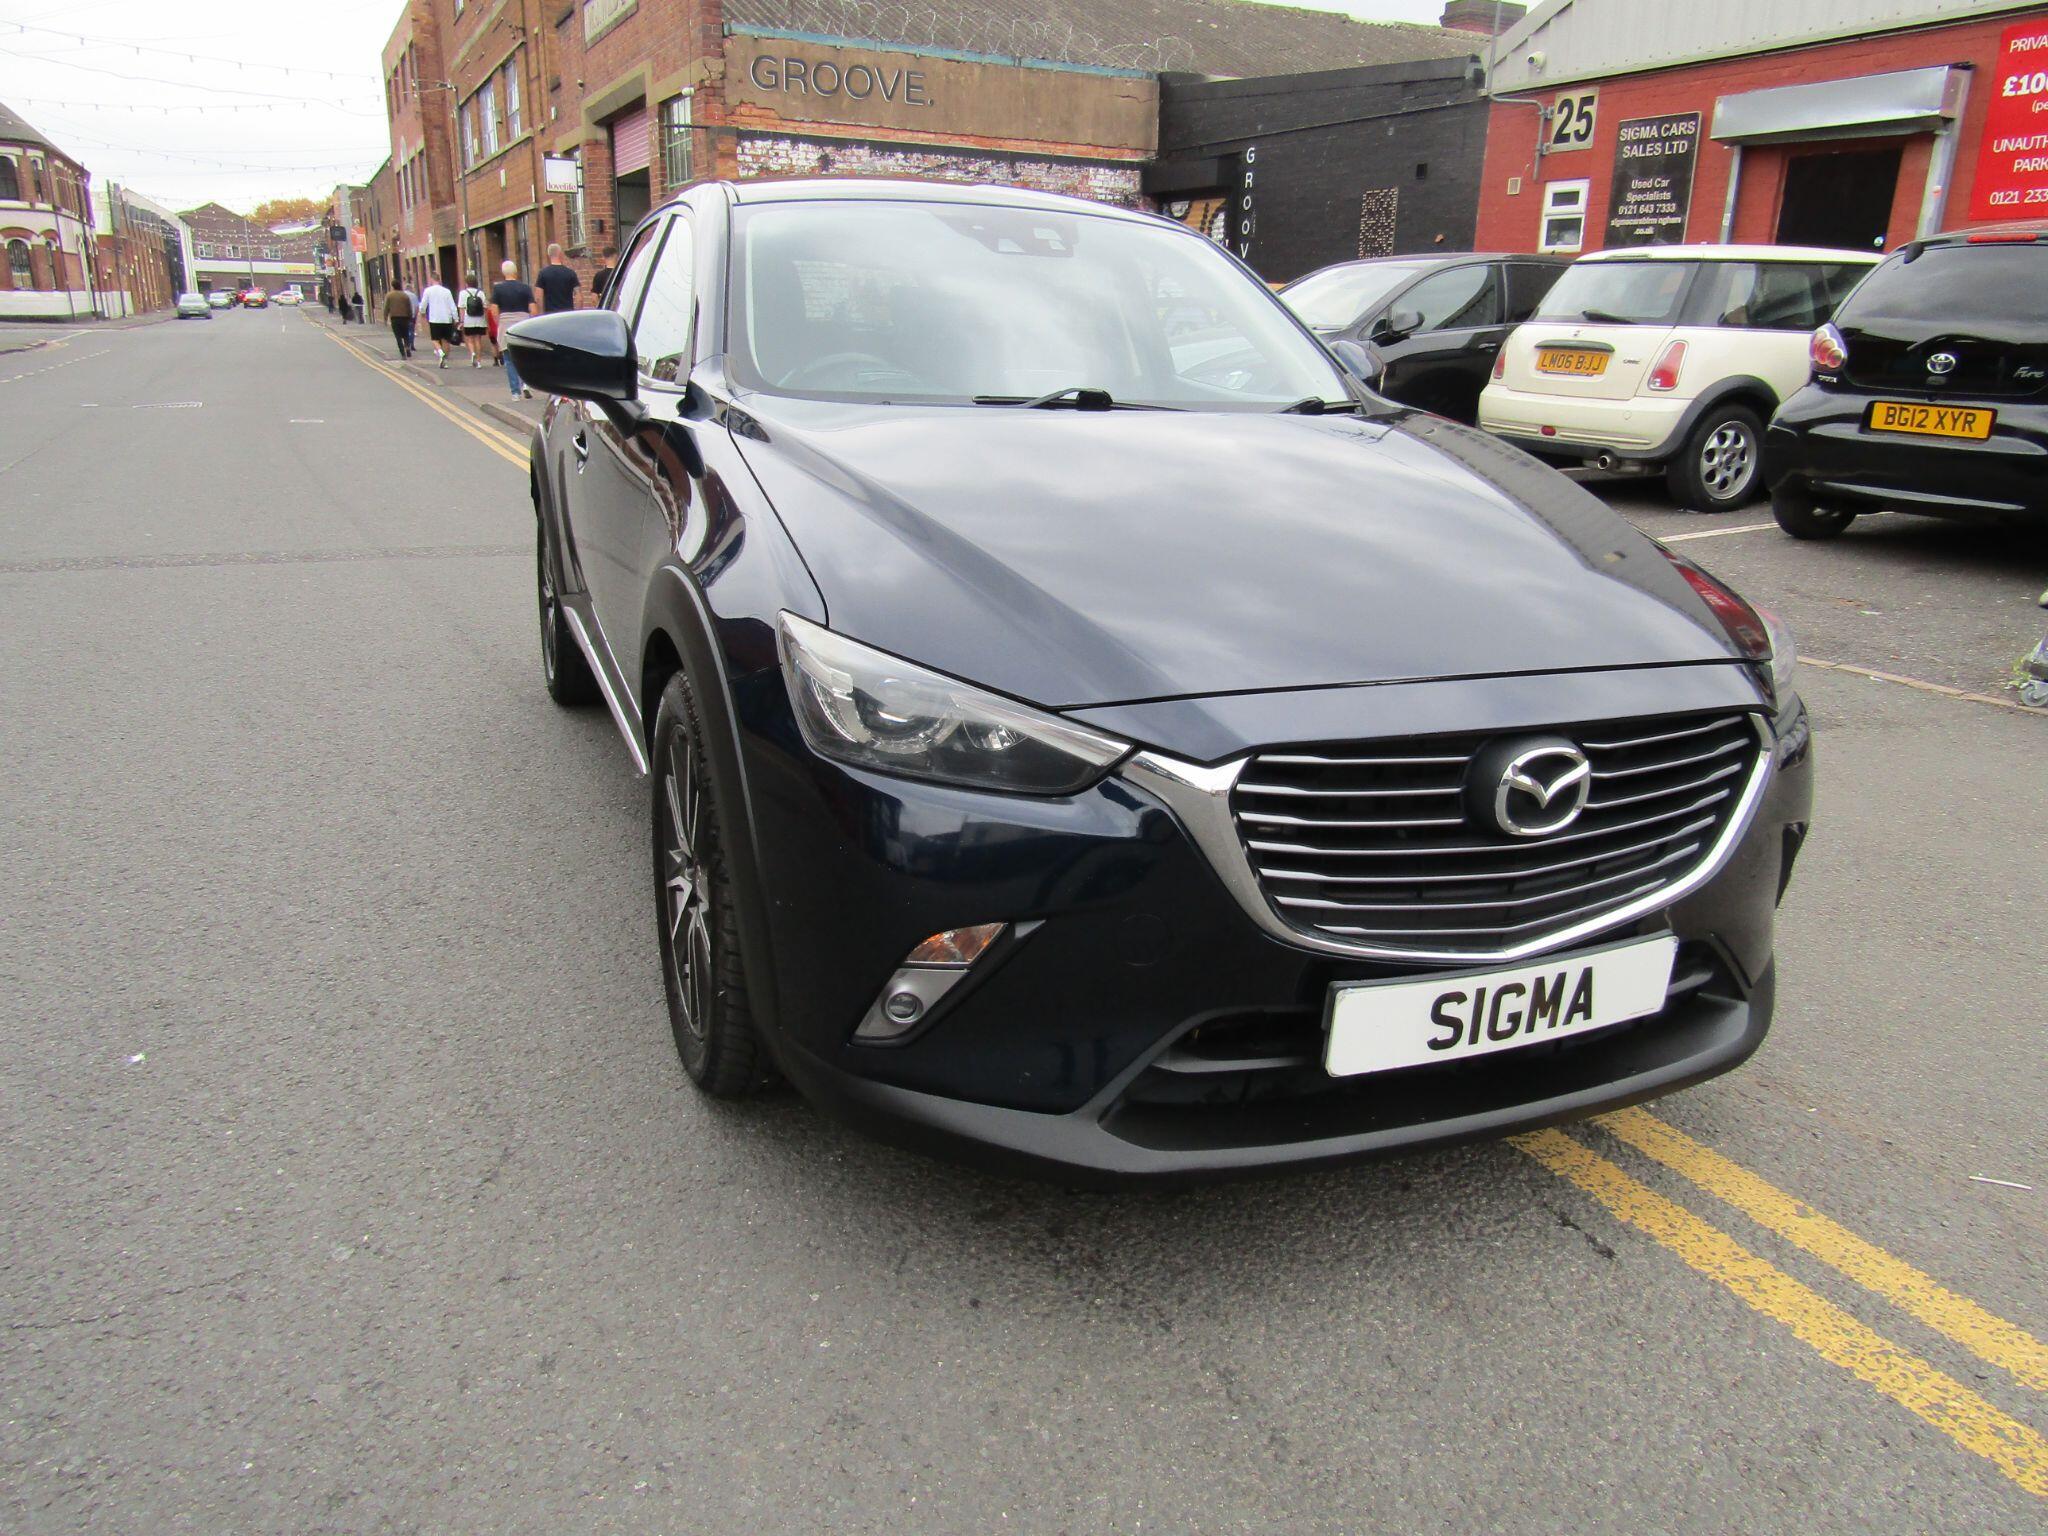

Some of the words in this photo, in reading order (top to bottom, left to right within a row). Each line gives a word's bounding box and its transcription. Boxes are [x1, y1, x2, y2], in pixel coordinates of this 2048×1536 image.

[2010, 34, 2048, 53] PRIVA
[2002, 72, 2048, 97] £10
[1552, 95, 1595, 144] 25
[1619, 126, 1659, 142] SIGMA
[1661, 120, 1696, 137] CARS
[1622, 143, 1662, 159] SALES
[1664, 140, 1688, 155] LTD
[1631, 179, 1653, 189] Used
[1654, 177, 1671, 188] Car
[1626, 191, 1672, 203] Specialists
[1989, 190, 2021, 206] 0121
[1618, 205, 1637, 215] 0121
[1639, 204, 1654, 214] 643
[1656, 202, 1676, 213] 7333
[1541, 353, 1573, 369] LM06
[1884, 406, 1929, 428] BG12
[1933, 409, 1977, 433] XYR
[1426, 966, 1593, 1050] SIGMA
